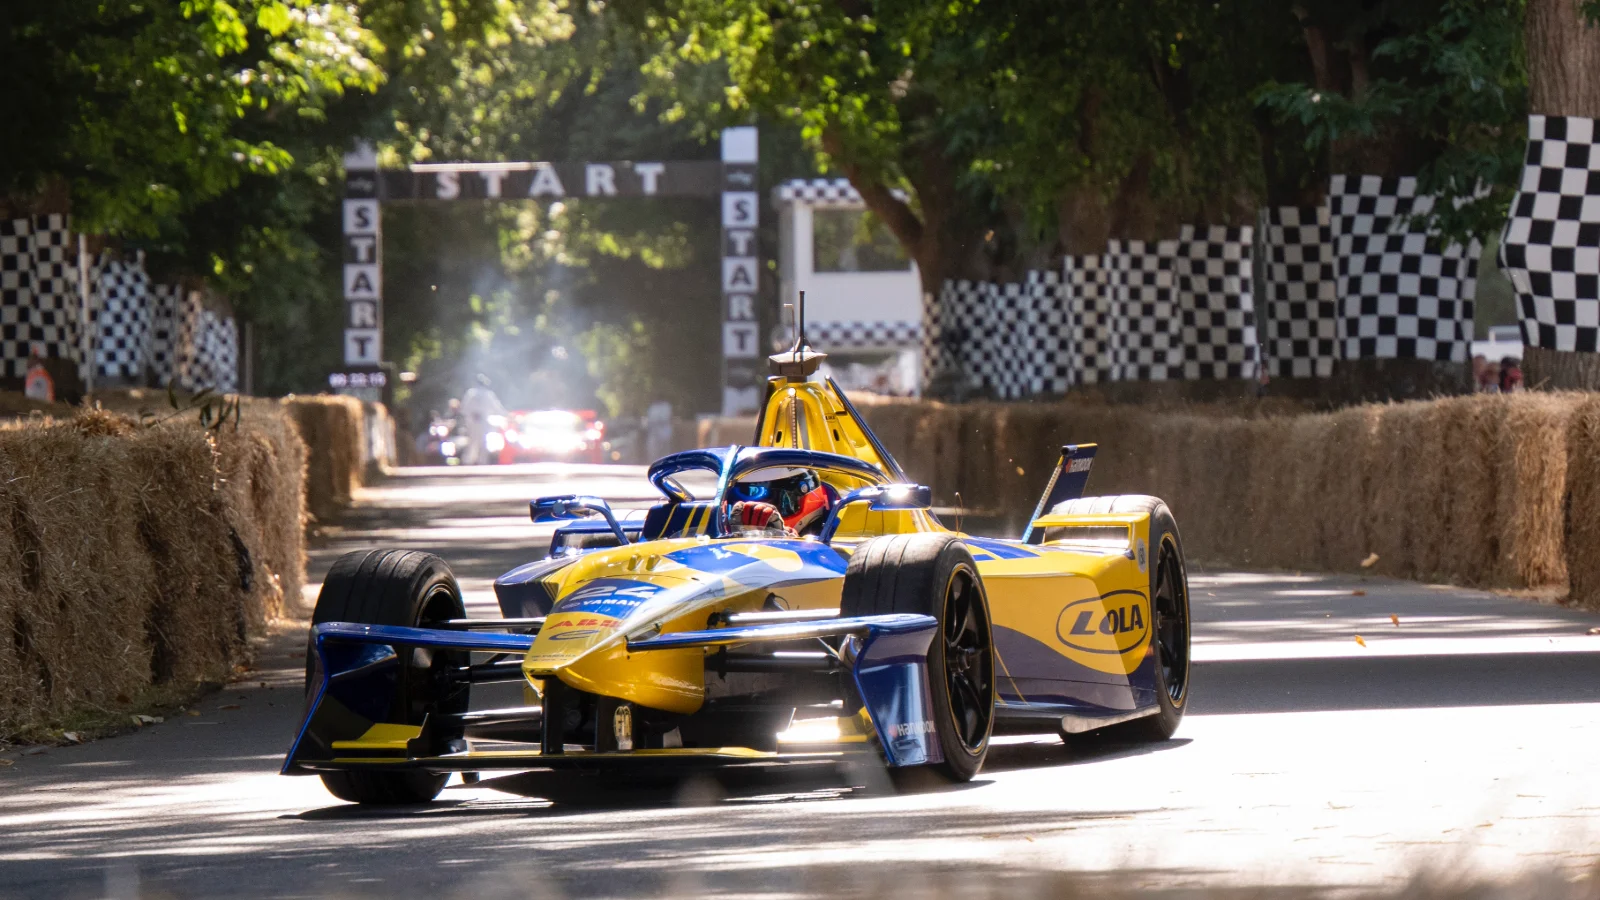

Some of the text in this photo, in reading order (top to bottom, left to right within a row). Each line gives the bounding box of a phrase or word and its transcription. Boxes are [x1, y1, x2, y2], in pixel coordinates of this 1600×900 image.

[436, 163, 665, 198] START
[350, 205, 376, 358] START
[729, 200, 754, 351] START
[1069, 604, 1144, 635] LOLA
